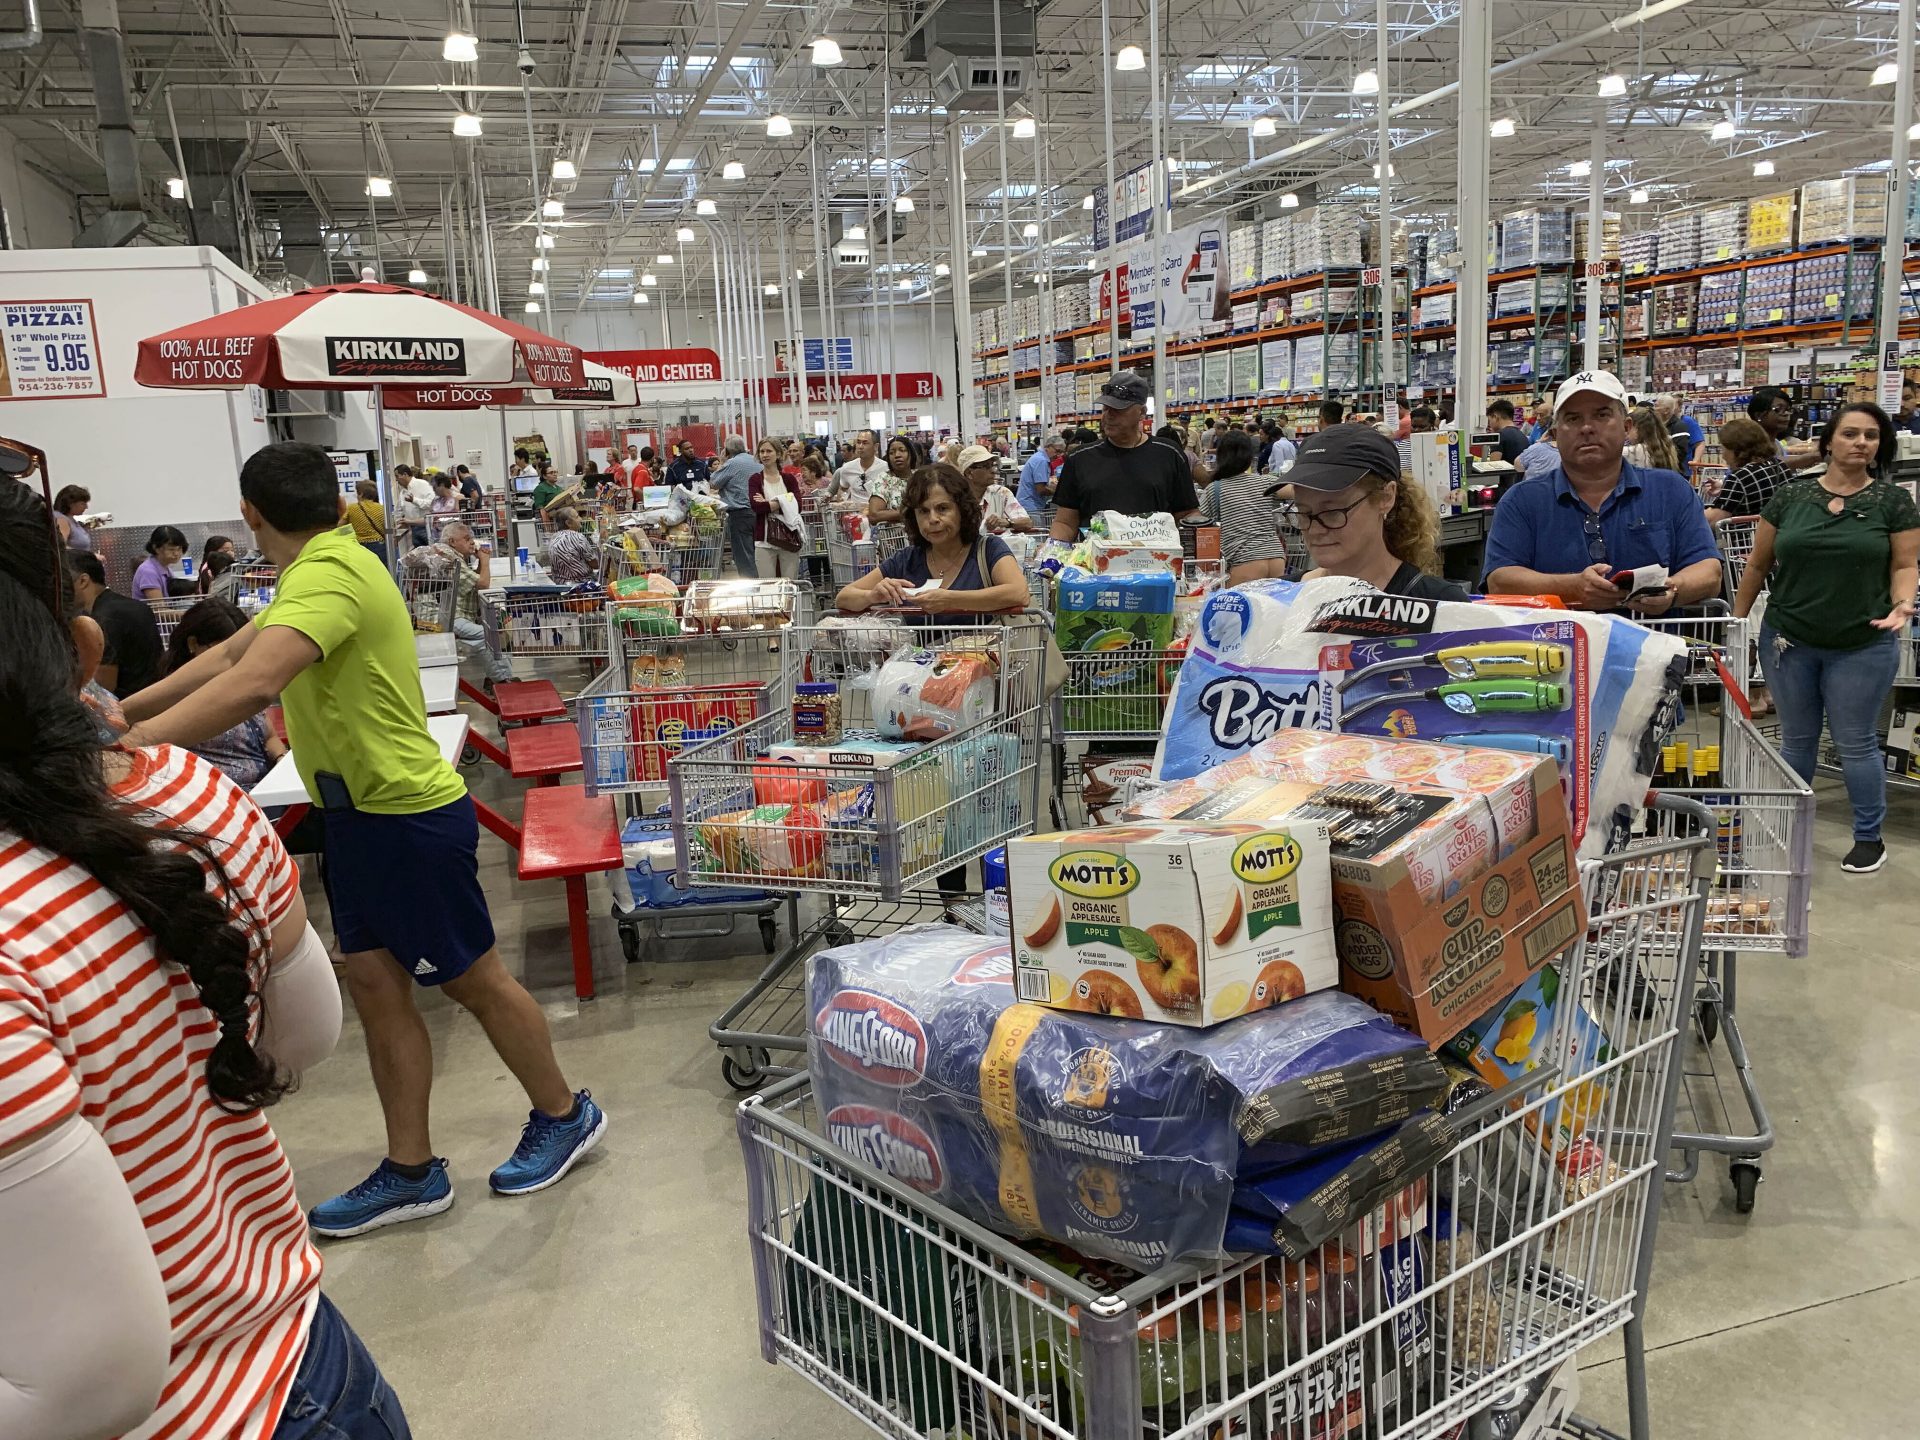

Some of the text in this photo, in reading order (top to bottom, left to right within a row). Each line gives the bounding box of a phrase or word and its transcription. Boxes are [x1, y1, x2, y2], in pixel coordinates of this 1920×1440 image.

[1096, 203, 1108, 219] CAS
[1165, 255, 1182, 270] Card
[1587, 262, 1604, 277] 308
[1364, 270, 1380, 284] 306
[49, 304, 83, 312] QUALITY
[6, 312, 84, 327] PIZZA!
[30, 333, 59, 342] Whole
[61, 332, 86, 341] Pizza
[160, 337, 255, 358] 100% ALL BEEF
[334, 341, 460, 361] KIRKLAND
[525, 343, 543, 360] 100%
[544, 345, 558, 362] ALL
[558, 347, 573, 364] BEEF
[44, 343, 90, 372] 9.95
[172, 359, 243, 379] HOT DOGS
[336, 360, 460, 377] Signature
[534, 364, 572, 383] HOT DOGS
[636, 363, 714, 382] AID CENTER
[18, 382, 94, 391] 954-236-7857
[417, 389, 492, 403] HOT DOGS
[1130, 519, 1167, 530] Organic
[1120, 527, 1172, 541] EDAMAME
[1067, 591, 1084, 604] 12
[1216, 594, 1241, 604] WIDE
[1212, 602, 1244, 612] SHEETS
[1546, 623, 1558, 640] XL
[1069, 638, 1153, 688] Bounty
[1321, 680, 1334, 731] Utility
[831, 754, 873, 764] KIRKLAND
[1109, 767, 1145, 777] Premier
[1510, 789, 1533, 816] CUP
[1576, 809, 1584, 836] DANGER:
[1317, 826, 1327, 837] 36
[1453, 823, 1478, 853] CUP
[1168, 854, 1183, 865] 36
[1447, 831, 1488, 873] NOODLES
[1536, 864, 1551, 884] 24
[1551, 861, 1565, 873] PACK
[1540, 878, 1553, 895] 2.5
[1554, 869, 1566, 884] OZ
[1252, 884, 1289, 900] ORGANIC
[1072, 902, 1117, 914] ORGANIC
[1251, 894, 1292, 911] APPLESAUCE
[1070, 912, 1121, 924] APPLESAUCE
[1263, 910, 1283, 923] APPLE
[1446, 904, 1467, 927] NISSIN
[1084, 927, 1109, 937] APPLE
[1351, 934, 1367, 945] NO
[1349, 943, 1382, 955] ADDED
[1443, 918, 1484, 966] CUP
[1356, 955, 1381, 967] MSG
[1429, 928, 1505, 1007] NOODLES
[1442, 980, 1483, 1018] CHICKEN
[822, 1009, 918, 1067] KINGSFORD
[1458, 1033, 1476, 1053] 16
[1061, 1054, 1121, 1091] WORKS WITH
[1038, 1118, 1144, 1156] PROFESSIONAL
[1073, 1201, 1134, 1230] CERAMIC GRILLS
